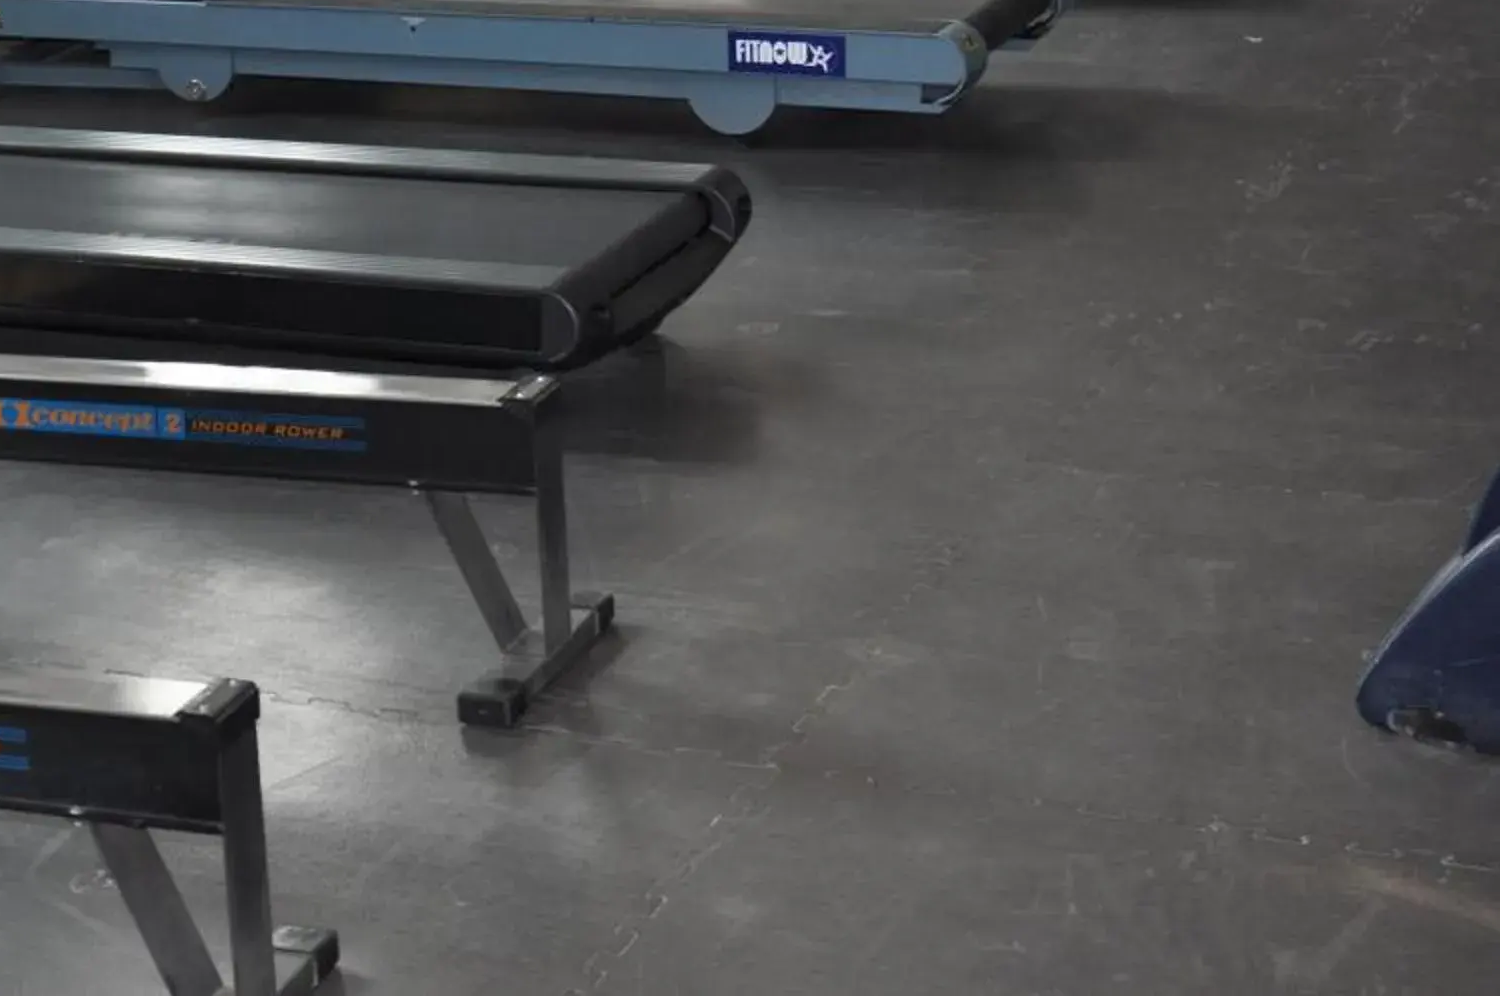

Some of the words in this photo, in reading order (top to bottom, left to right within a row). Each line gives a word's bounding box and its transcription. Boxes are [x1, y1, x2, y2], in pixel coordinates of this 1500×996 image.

[164, 412, 181, 434] 2
[191, 419, 266, 435] INDOOR
[273, 424, 345, 440] ROWER
